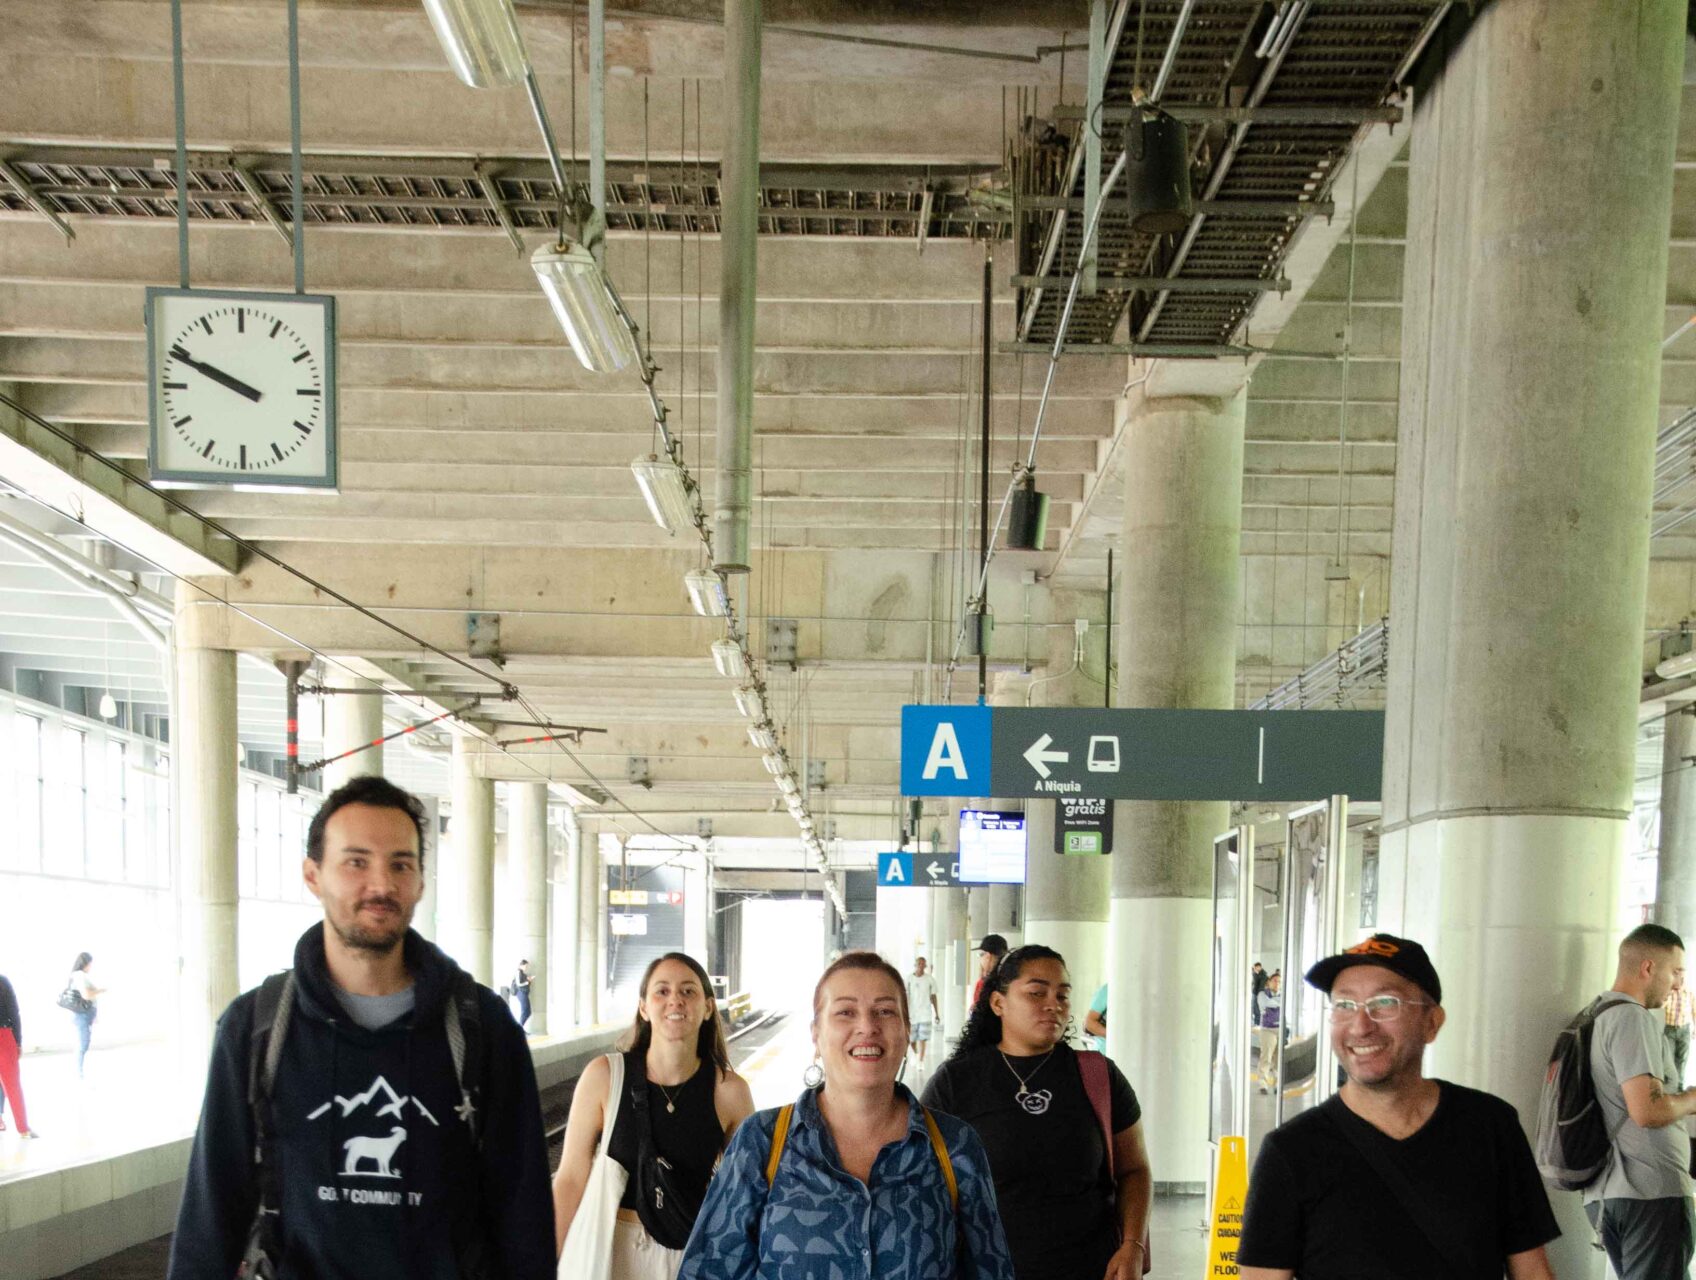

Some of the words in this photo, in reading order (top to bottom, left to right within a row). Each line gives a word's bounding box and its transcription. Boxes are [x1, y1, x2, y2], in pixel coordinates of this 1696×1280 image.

[922, 722, 969, 779] A
[1034, 780, 1043, 791] A
[1065, 803, 1106, 817] gratis
[886, 858, 905, 881] A
[318, 1186, 350, 1201] GOT
[350, 1188, 423, 1206] COMMUNTY
[1218, 1213, 1243, 1224] CAUTIO
[1217, 1228, 1241, 1238] CUIDAD
[1220, 1251, 1237, 1262] WE
[1214, 1265, 1240, 1275] FLOO
